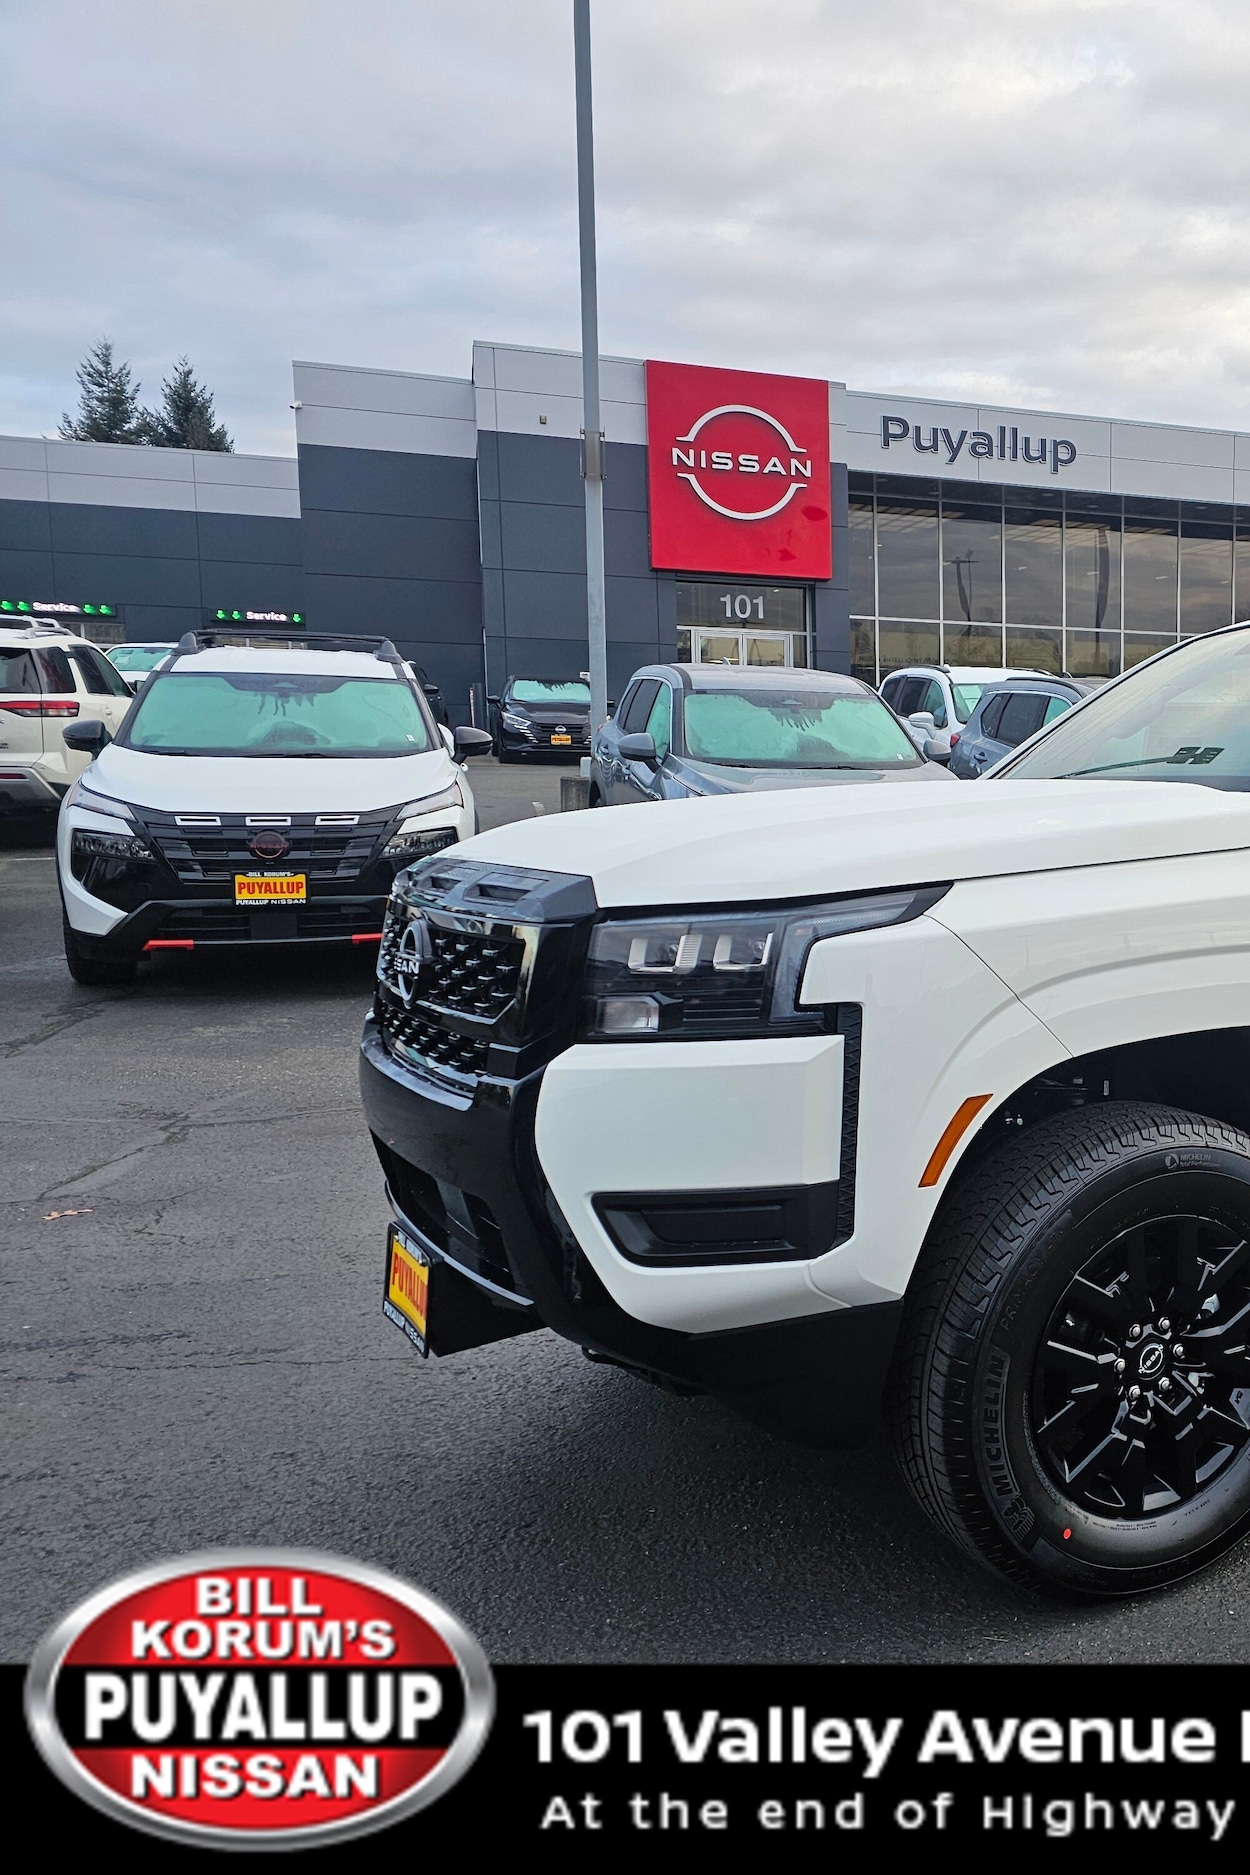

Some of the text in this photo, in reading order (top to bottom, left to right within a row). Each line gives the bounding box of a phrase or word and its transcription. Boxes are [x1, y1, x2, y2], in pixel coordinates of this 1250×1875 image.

[880, 414, 1078, 474] Puyallup
[671, 446, 812, 478] NISSAN
[33, 601, 80, 613] Service
[246, 611, 288, 621] Service
[719, 593, 765, 620] 101
[237, 881, 304, 895] PUYALLUP
[983, 1353, 1014, 1497] MICHELIN
